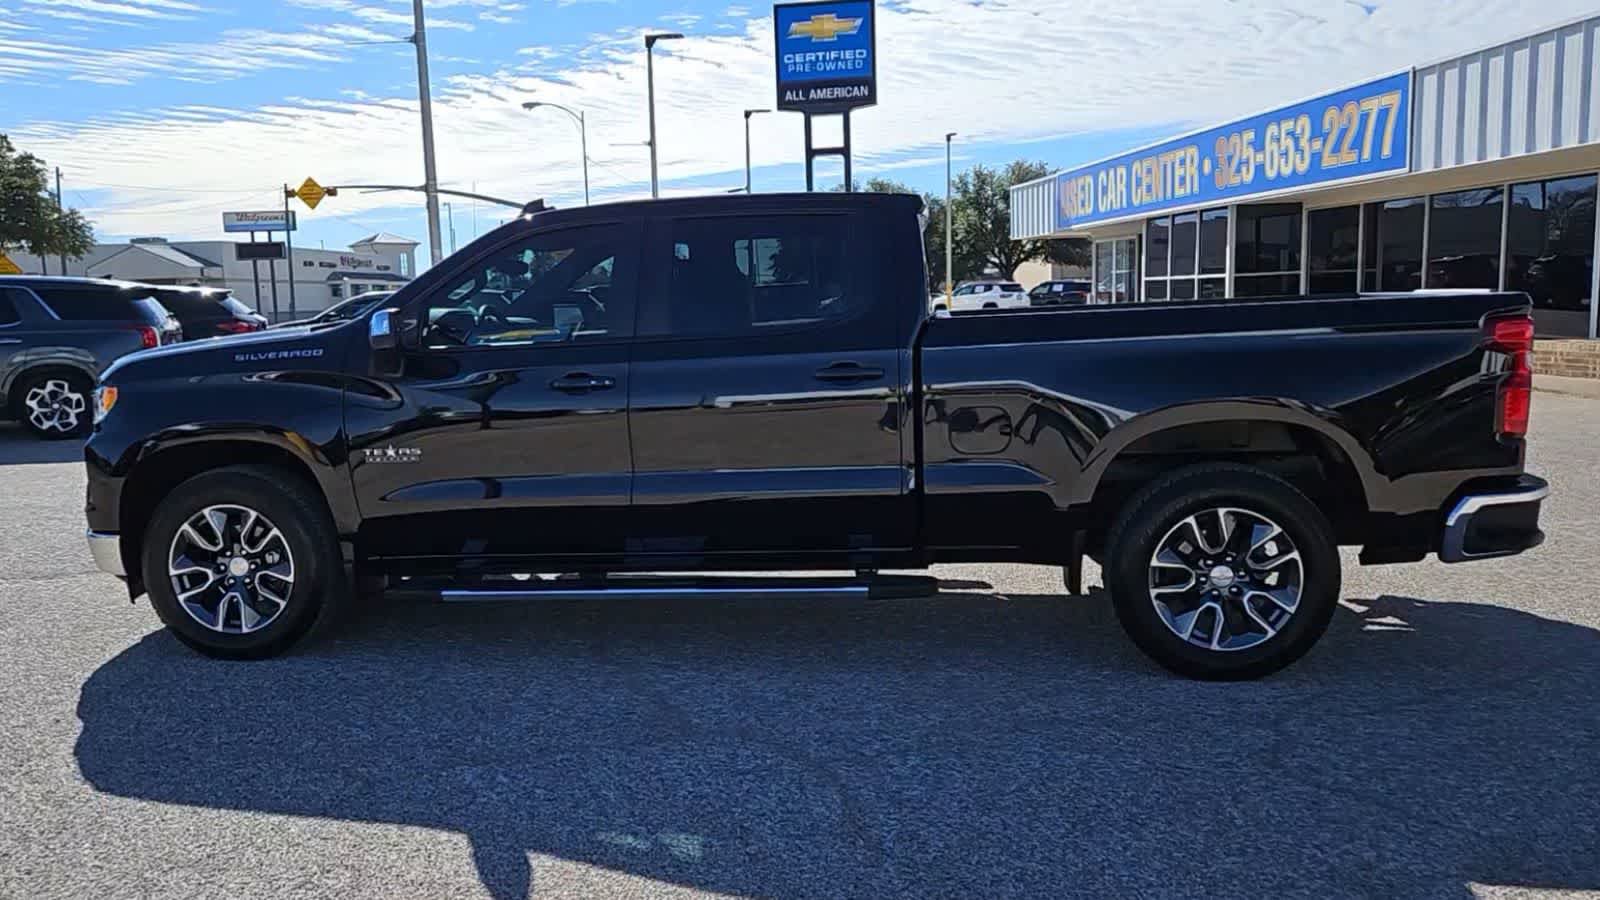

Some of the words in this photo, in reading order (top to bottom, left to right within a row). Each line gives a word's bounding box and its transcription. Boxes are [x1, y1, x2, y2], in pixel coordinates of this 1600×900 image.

[783, 49, 867, 64] CERTIFIED
[787, 60, 863, 73] PRE-OWNED
[785, 90, 806, 102] ALL
[809, 86, 868, 100] AMERICAN
[1098, 165, 1127, 213] CAR
[1131, 145, 1199, 207] CENTER
[1215, 91, 1401, 190] 325-653-2277
[234, 349, 323, 361] SILVERADO
